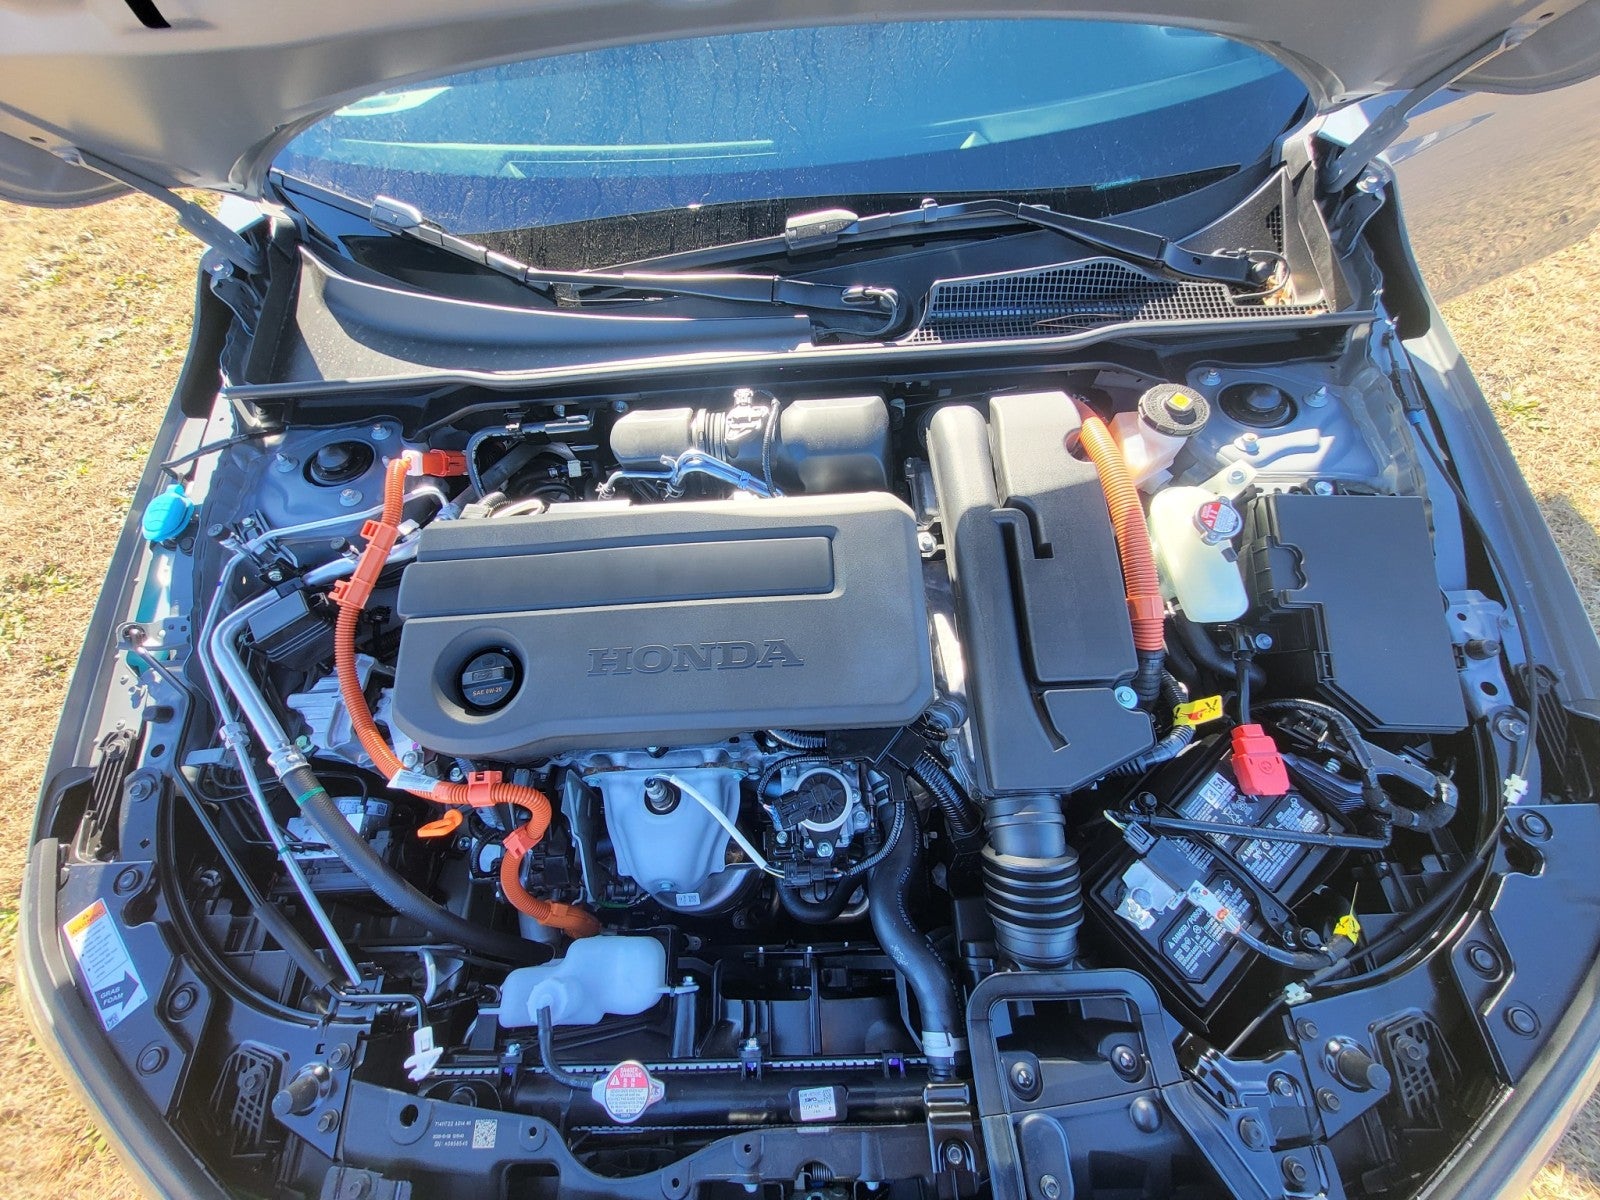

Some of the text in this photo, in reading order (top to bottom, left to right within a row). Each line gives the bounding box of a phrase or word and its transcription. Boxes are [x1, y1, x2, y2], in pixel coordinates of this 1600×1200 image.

[587, 638, 805, 677] HONDA
[1213, 777, 1227, 790] 5A
[100, 986, 121, 999] GRAB
[103, 993, 124, 1006] FOAM
